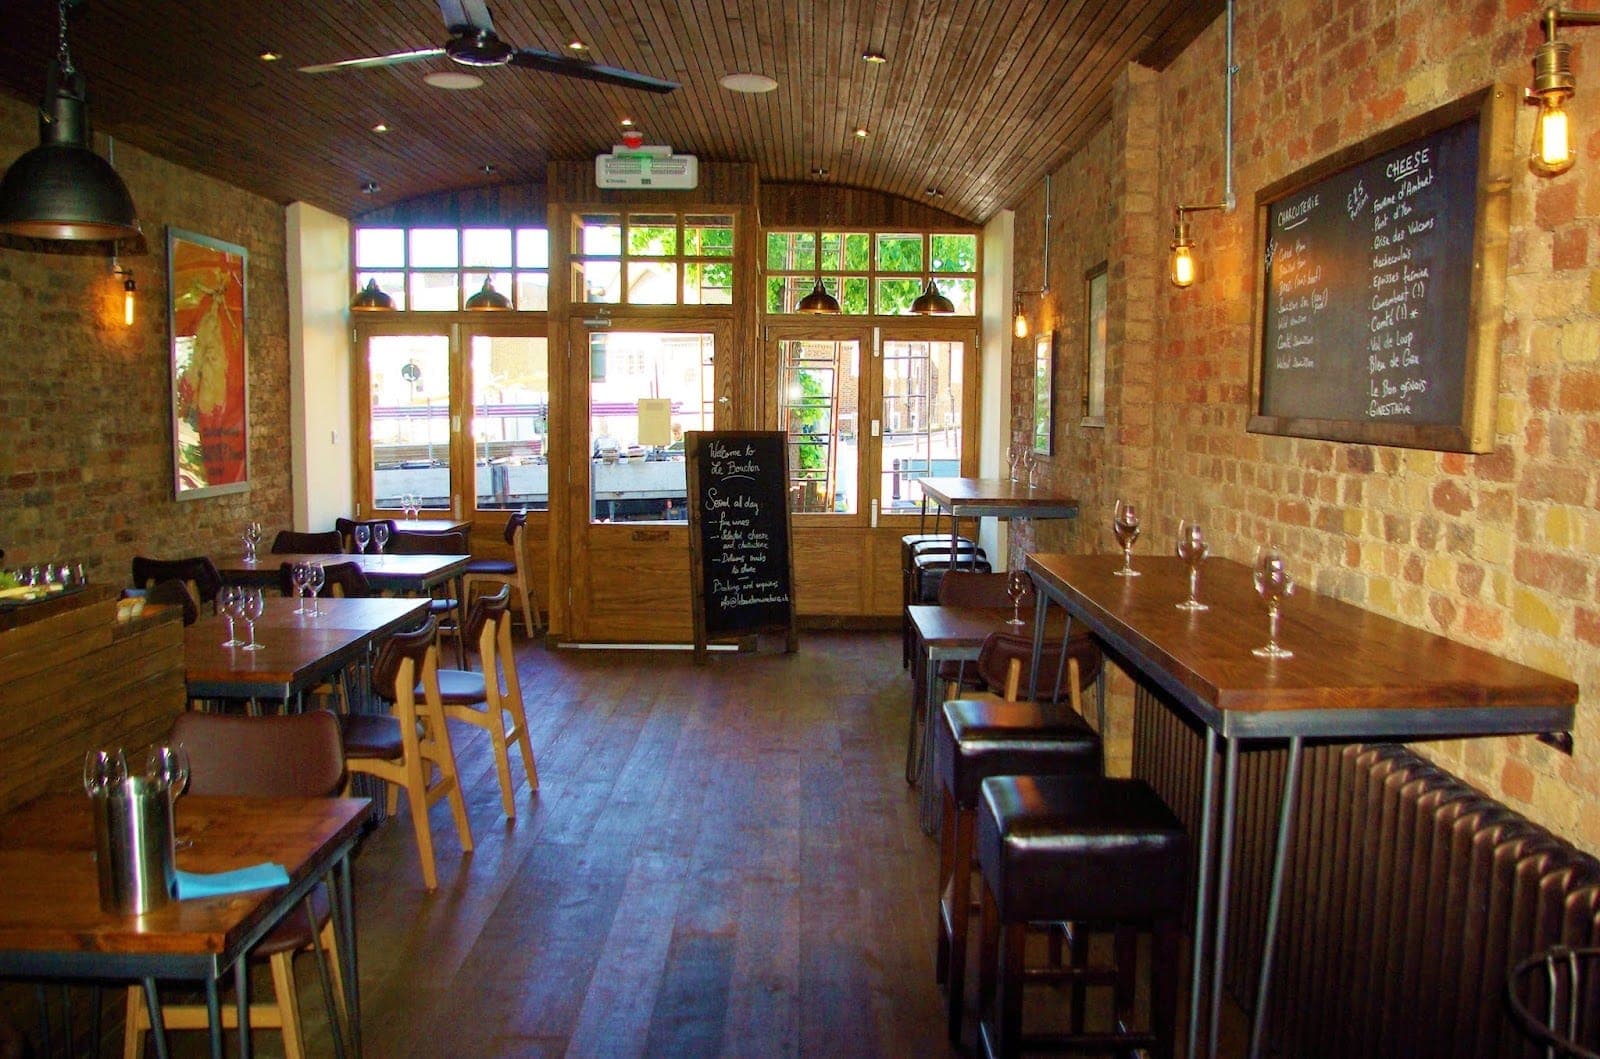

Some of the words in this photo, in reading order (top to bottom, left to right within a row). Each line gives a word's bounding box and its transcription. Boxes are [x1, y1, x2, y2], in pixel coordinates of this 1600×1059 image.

[1386, 148, 1429, 178] CHEESE
[1277, 194, 1320, 227] CHARCUTERIE
[1392, 227, 1405, 243] des
[1389, 351, 1400, 368] de
[1371, 379, 1379, 397] Le
[708, 440, 741, 459] Welcome
[745, 444, 756, 456] to
[711, 461, 723, 475] Le
[727, 460, 760, 475] Bouchon
[744, 496, 759, 516] day
